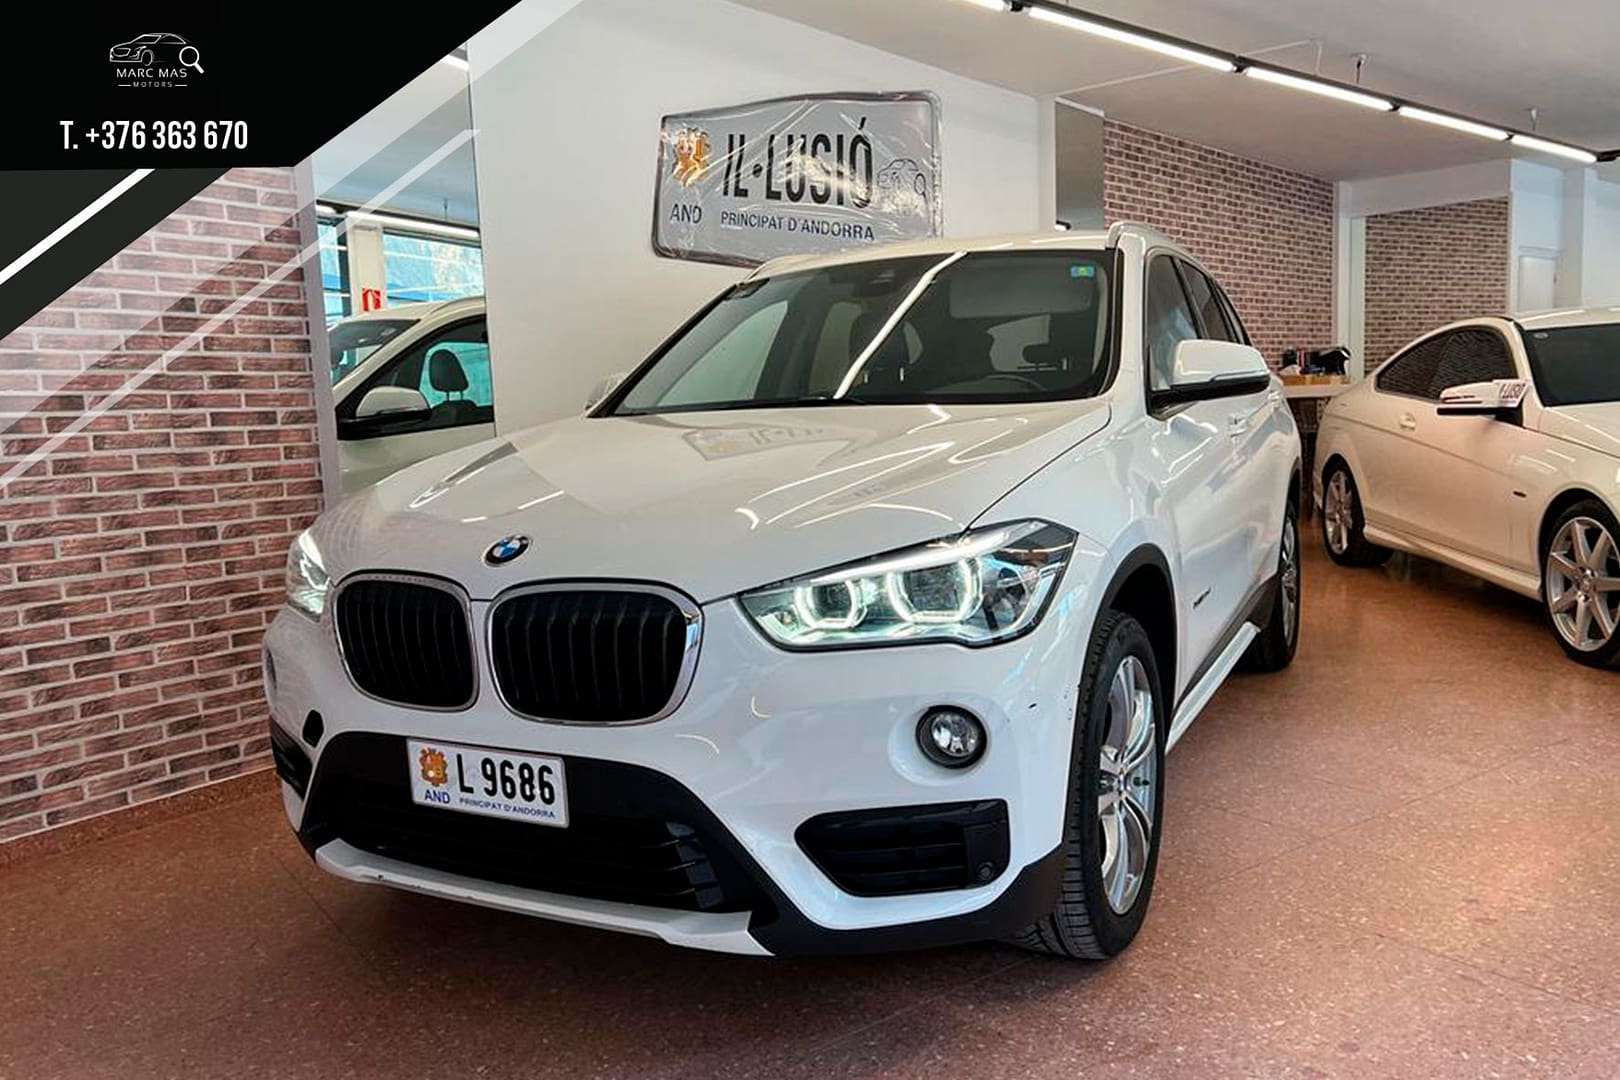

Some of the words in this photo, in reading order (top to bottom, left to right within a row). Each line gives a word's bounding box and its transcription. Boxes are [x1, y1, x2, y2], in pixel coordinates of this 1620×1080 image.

[669, 203, 703, 225] AND
[720, 210, 784, 231] PRINCIPAT
[787, 217, 875, 242] D'ANDORRA
[456, 753, 474, 794] L
[480, 757, 556, 806] 9686
[424, 788, 451, 804] AND
[459, 797, 502, 810] PRINCIPAT
[504, 803, 556, 818] D'ANDORRA
